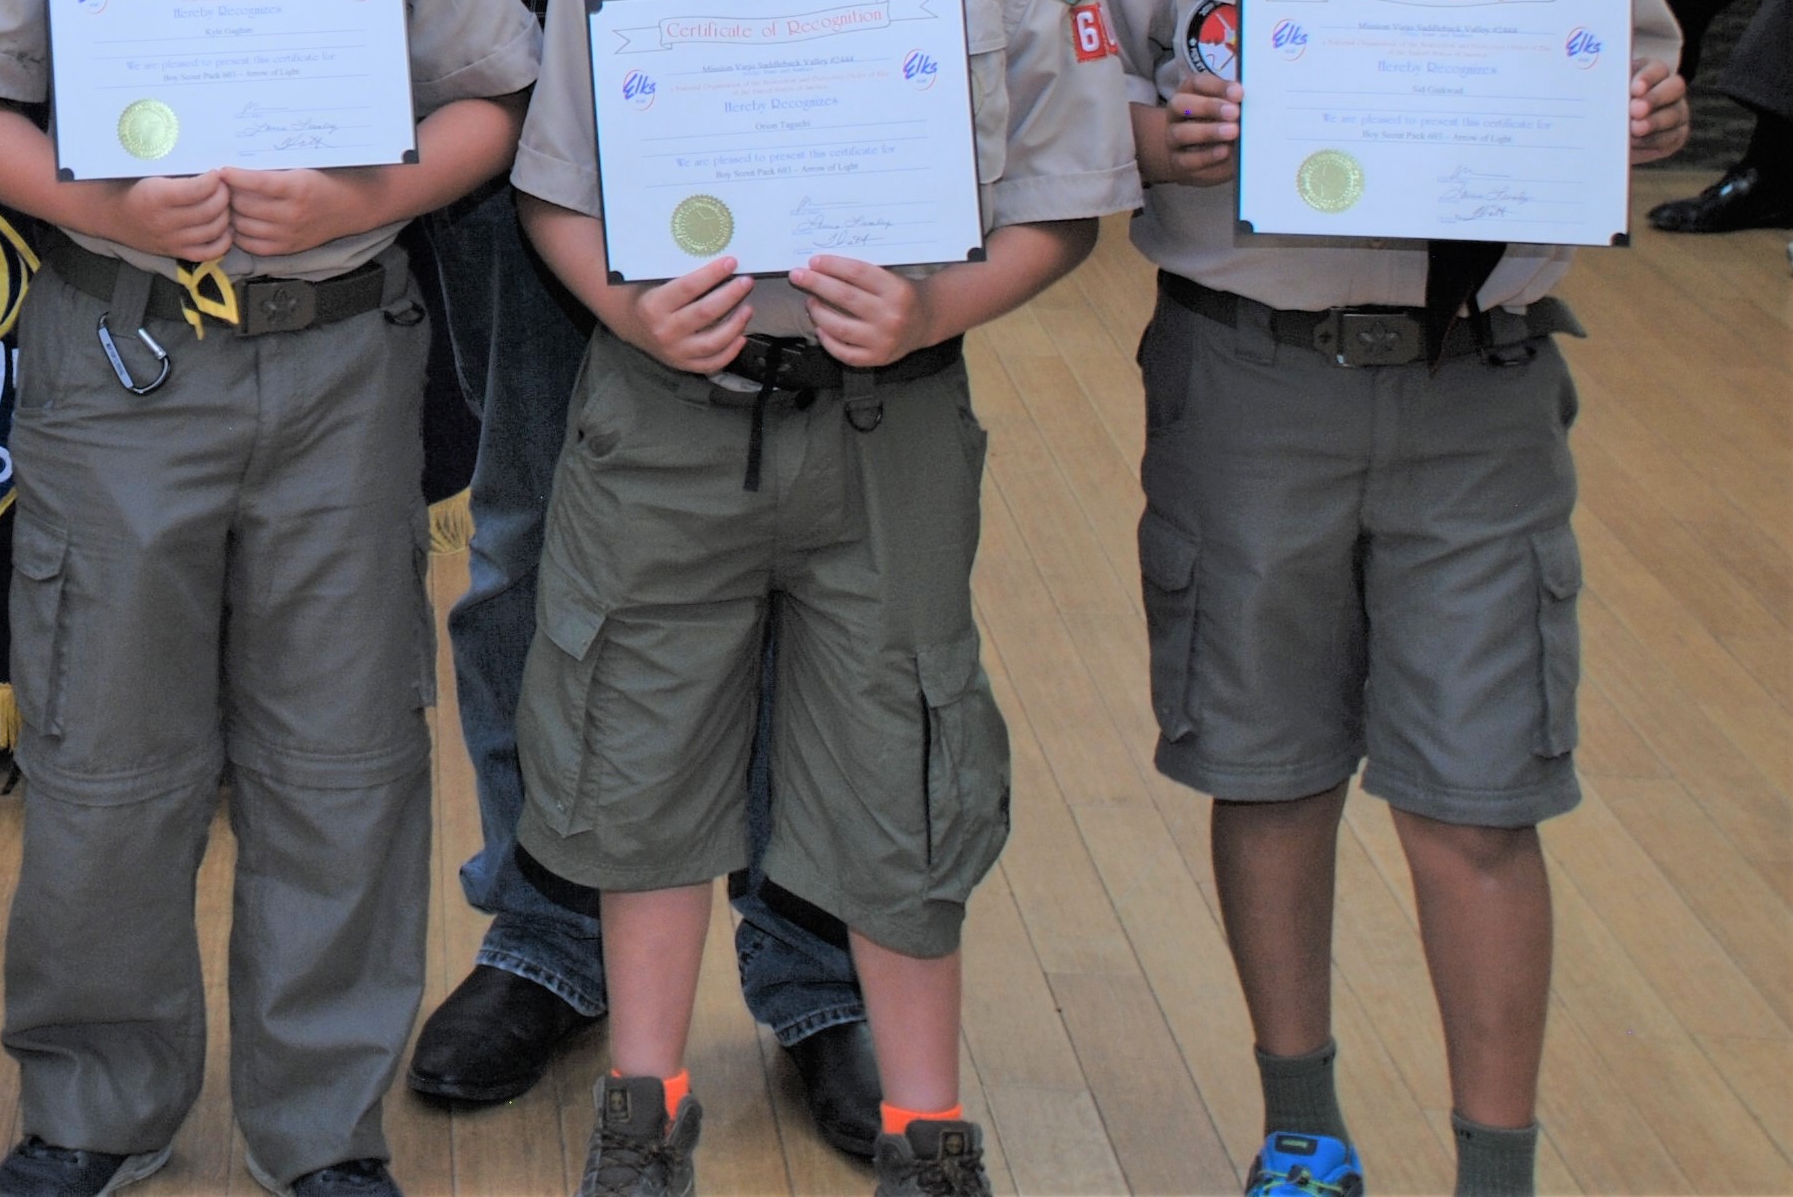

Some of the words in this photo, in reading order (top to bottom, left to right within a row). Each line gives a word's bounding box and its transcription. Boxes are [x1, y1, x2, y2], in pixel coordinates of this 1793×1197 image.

[173, 7, 214, 21] Hereby
[218, 3, 282, 20] Recognizes
[666, 21, 753, 38] Certificate
[761, 21, 779, 38] of
[787, 10, 882, 35] Recognition
[1274, 23, 1309, 48] Elks
[1567, 31, 1603, 58] Elks
[904, 54, 938, 81] Elks
[1378, 61, 1422, 76] Hereby
[1427, 62, 1497, 79] Recognizes
[624, 74, 656, 100] Elks
[724, 100, 767, 116] Hereby
[771, 94, 839, 114] Recognizes
[677, 159, 691, 168] We
[695, 159, 710, 167] are
[713, 154, 752, 168] pleased
[755, 154, 765, 163] to
[769, 151, 806, 164] present
[810, 149, 826, 159] this
[830, 146, 878, 157] certificate
[881, 145, 896, 154] for
